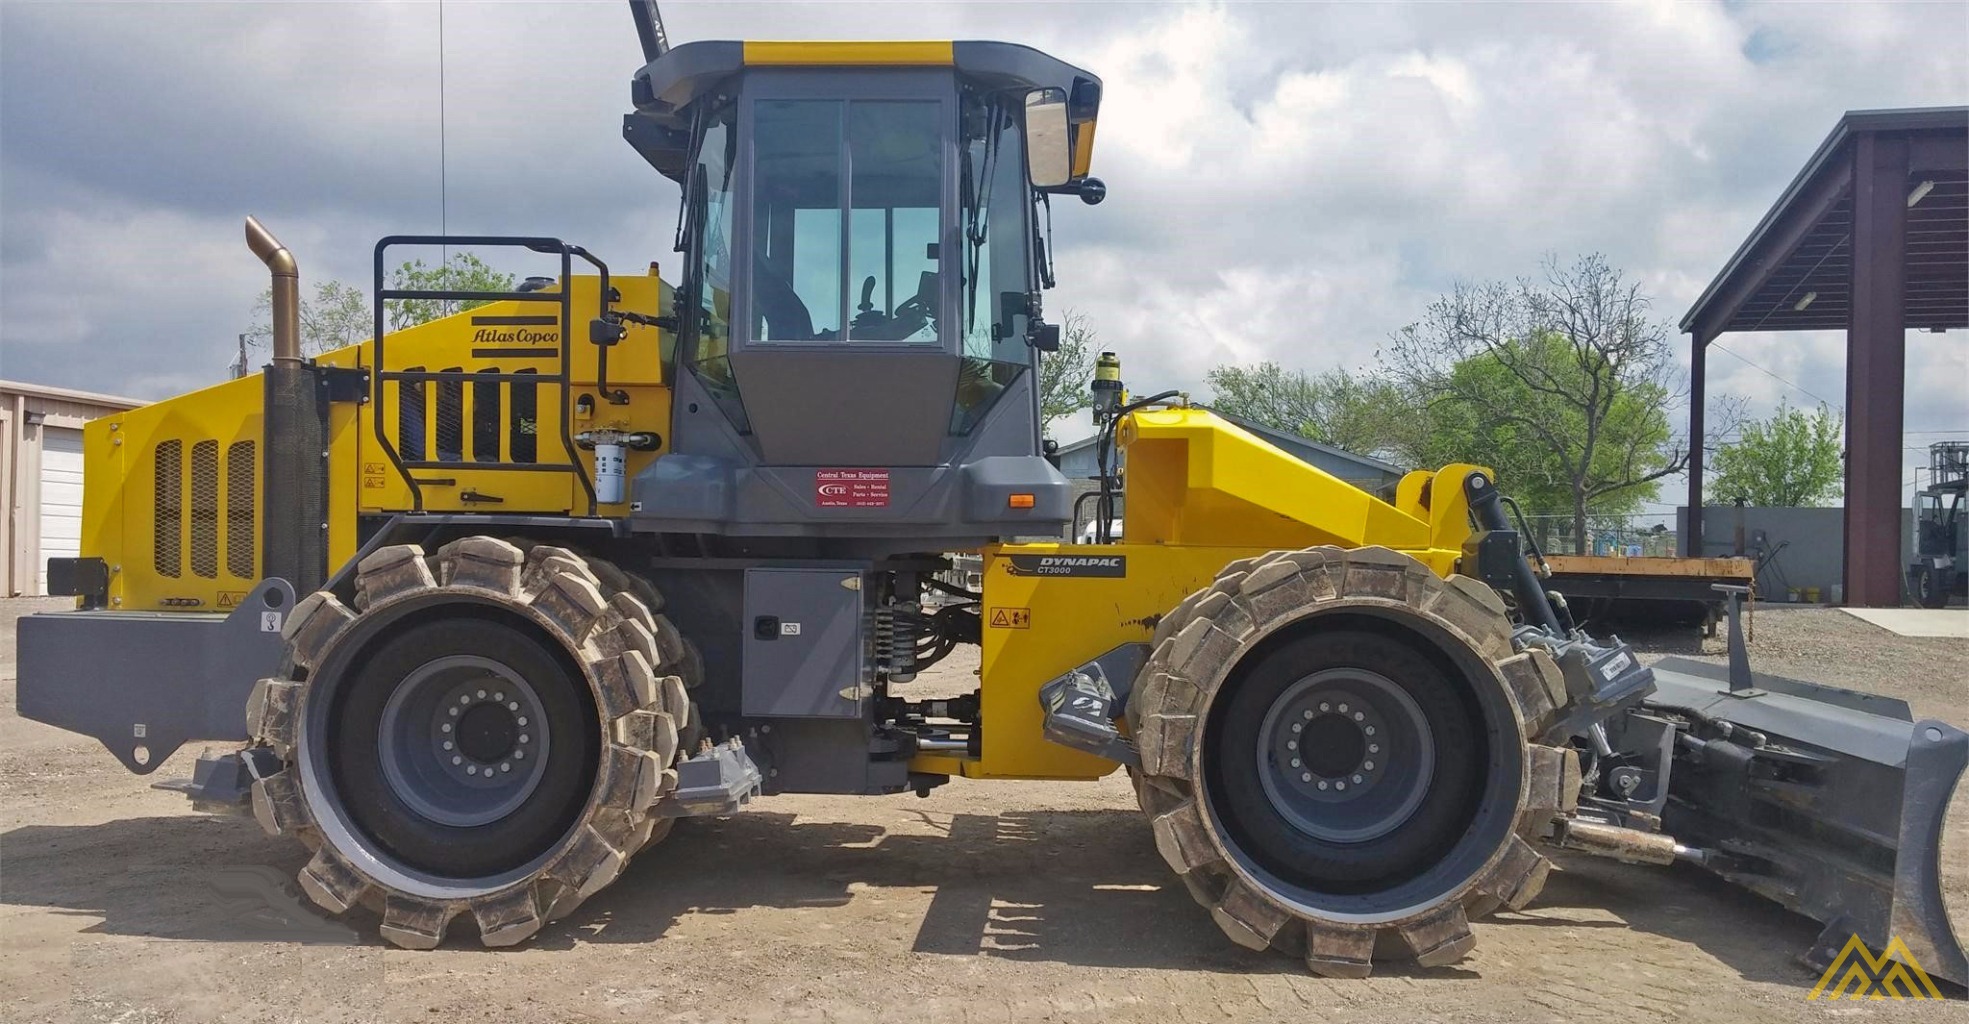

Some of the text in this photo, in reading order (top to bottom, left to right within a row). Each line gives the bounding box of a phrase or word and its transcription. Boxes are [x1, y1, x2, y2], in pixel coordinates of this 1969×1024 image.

[472, 328, 559, 345] Atlas Copco
[859, 472, 889, 480] Equipment
[825, 486, 847, 495] CTE
[1040, 558, 1120, 567] DYNAPAC
